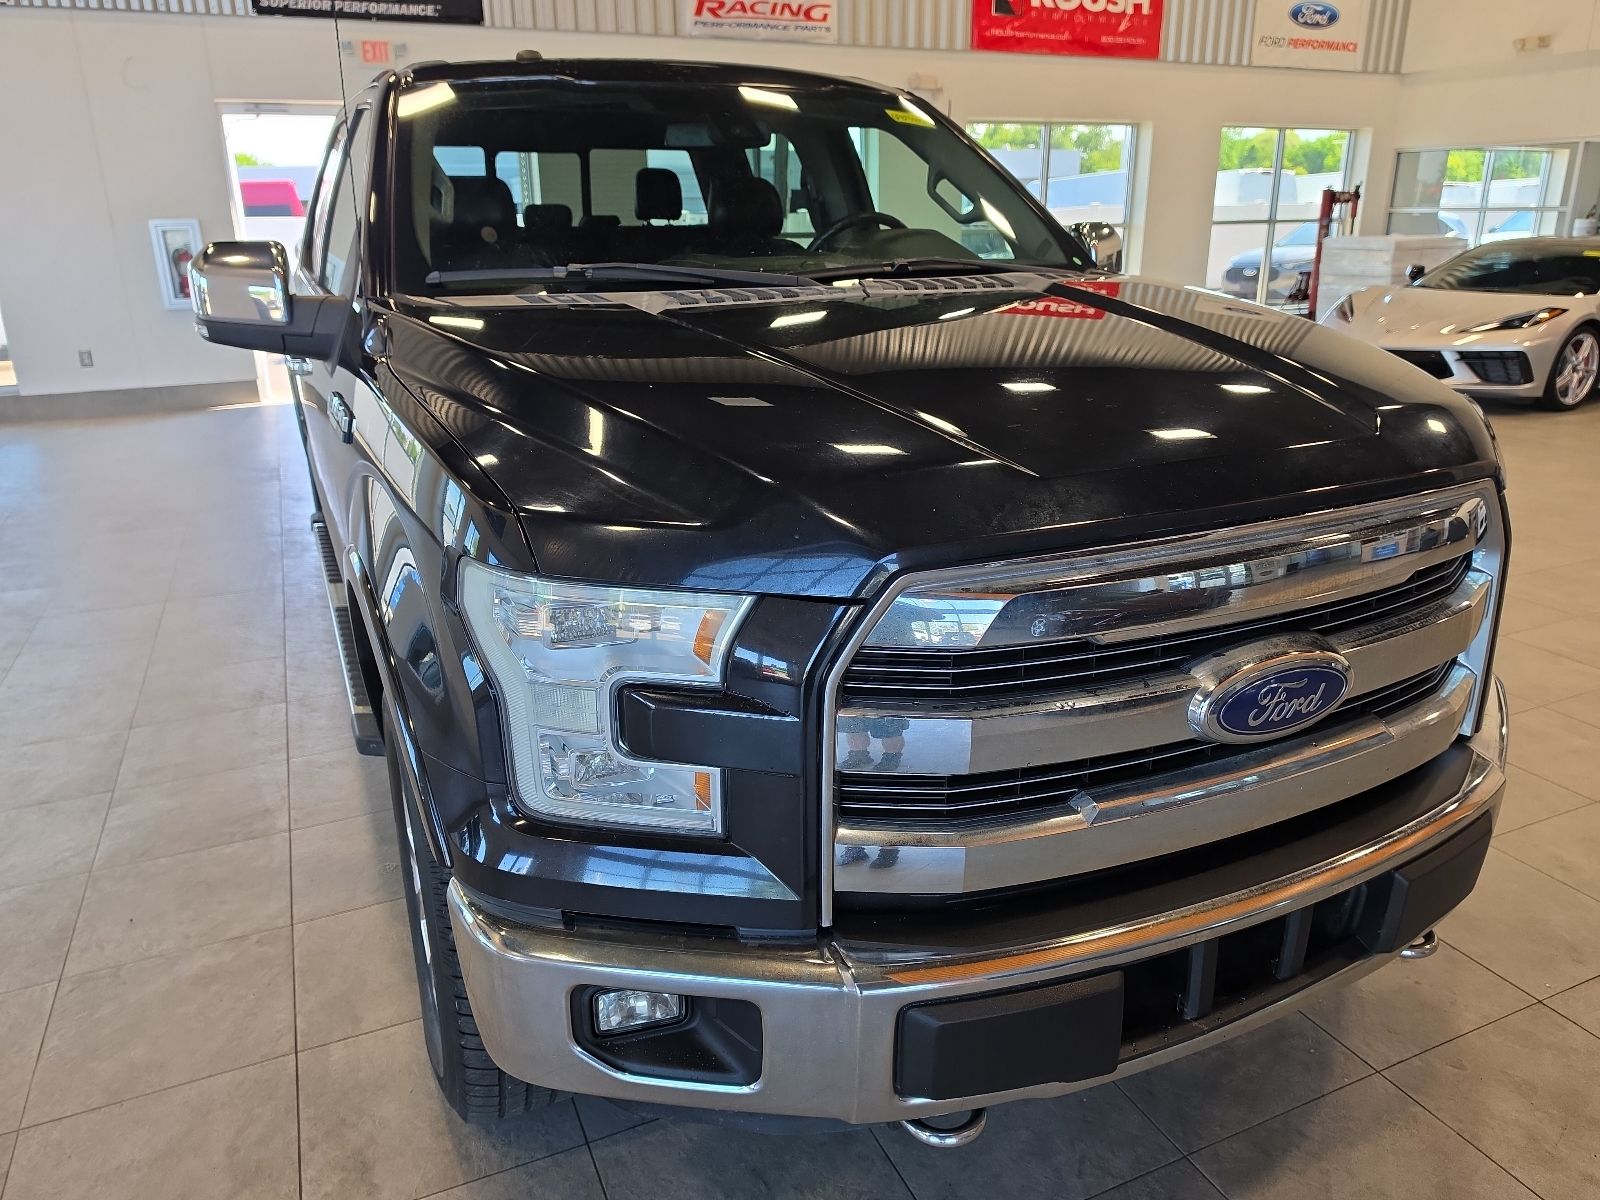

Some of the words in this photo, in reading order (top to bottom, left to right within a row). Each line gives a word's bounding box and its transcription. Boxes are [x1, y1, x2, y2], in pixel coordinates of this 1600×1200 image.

[259, 0, 332, 11] SUPERIOR
[693, 0, 832, 22] RACING
[1297, 3, 1331, 24] Ford
[693, 20, 792, 31] PERFORMANCE
[362, 41, 389, 63] EXIT
[1258, 35, 1285, 48] FORD
[1287, 38, 1358, 52] PERFORMANCE
[1247, 677, 1326, 727] Ford
